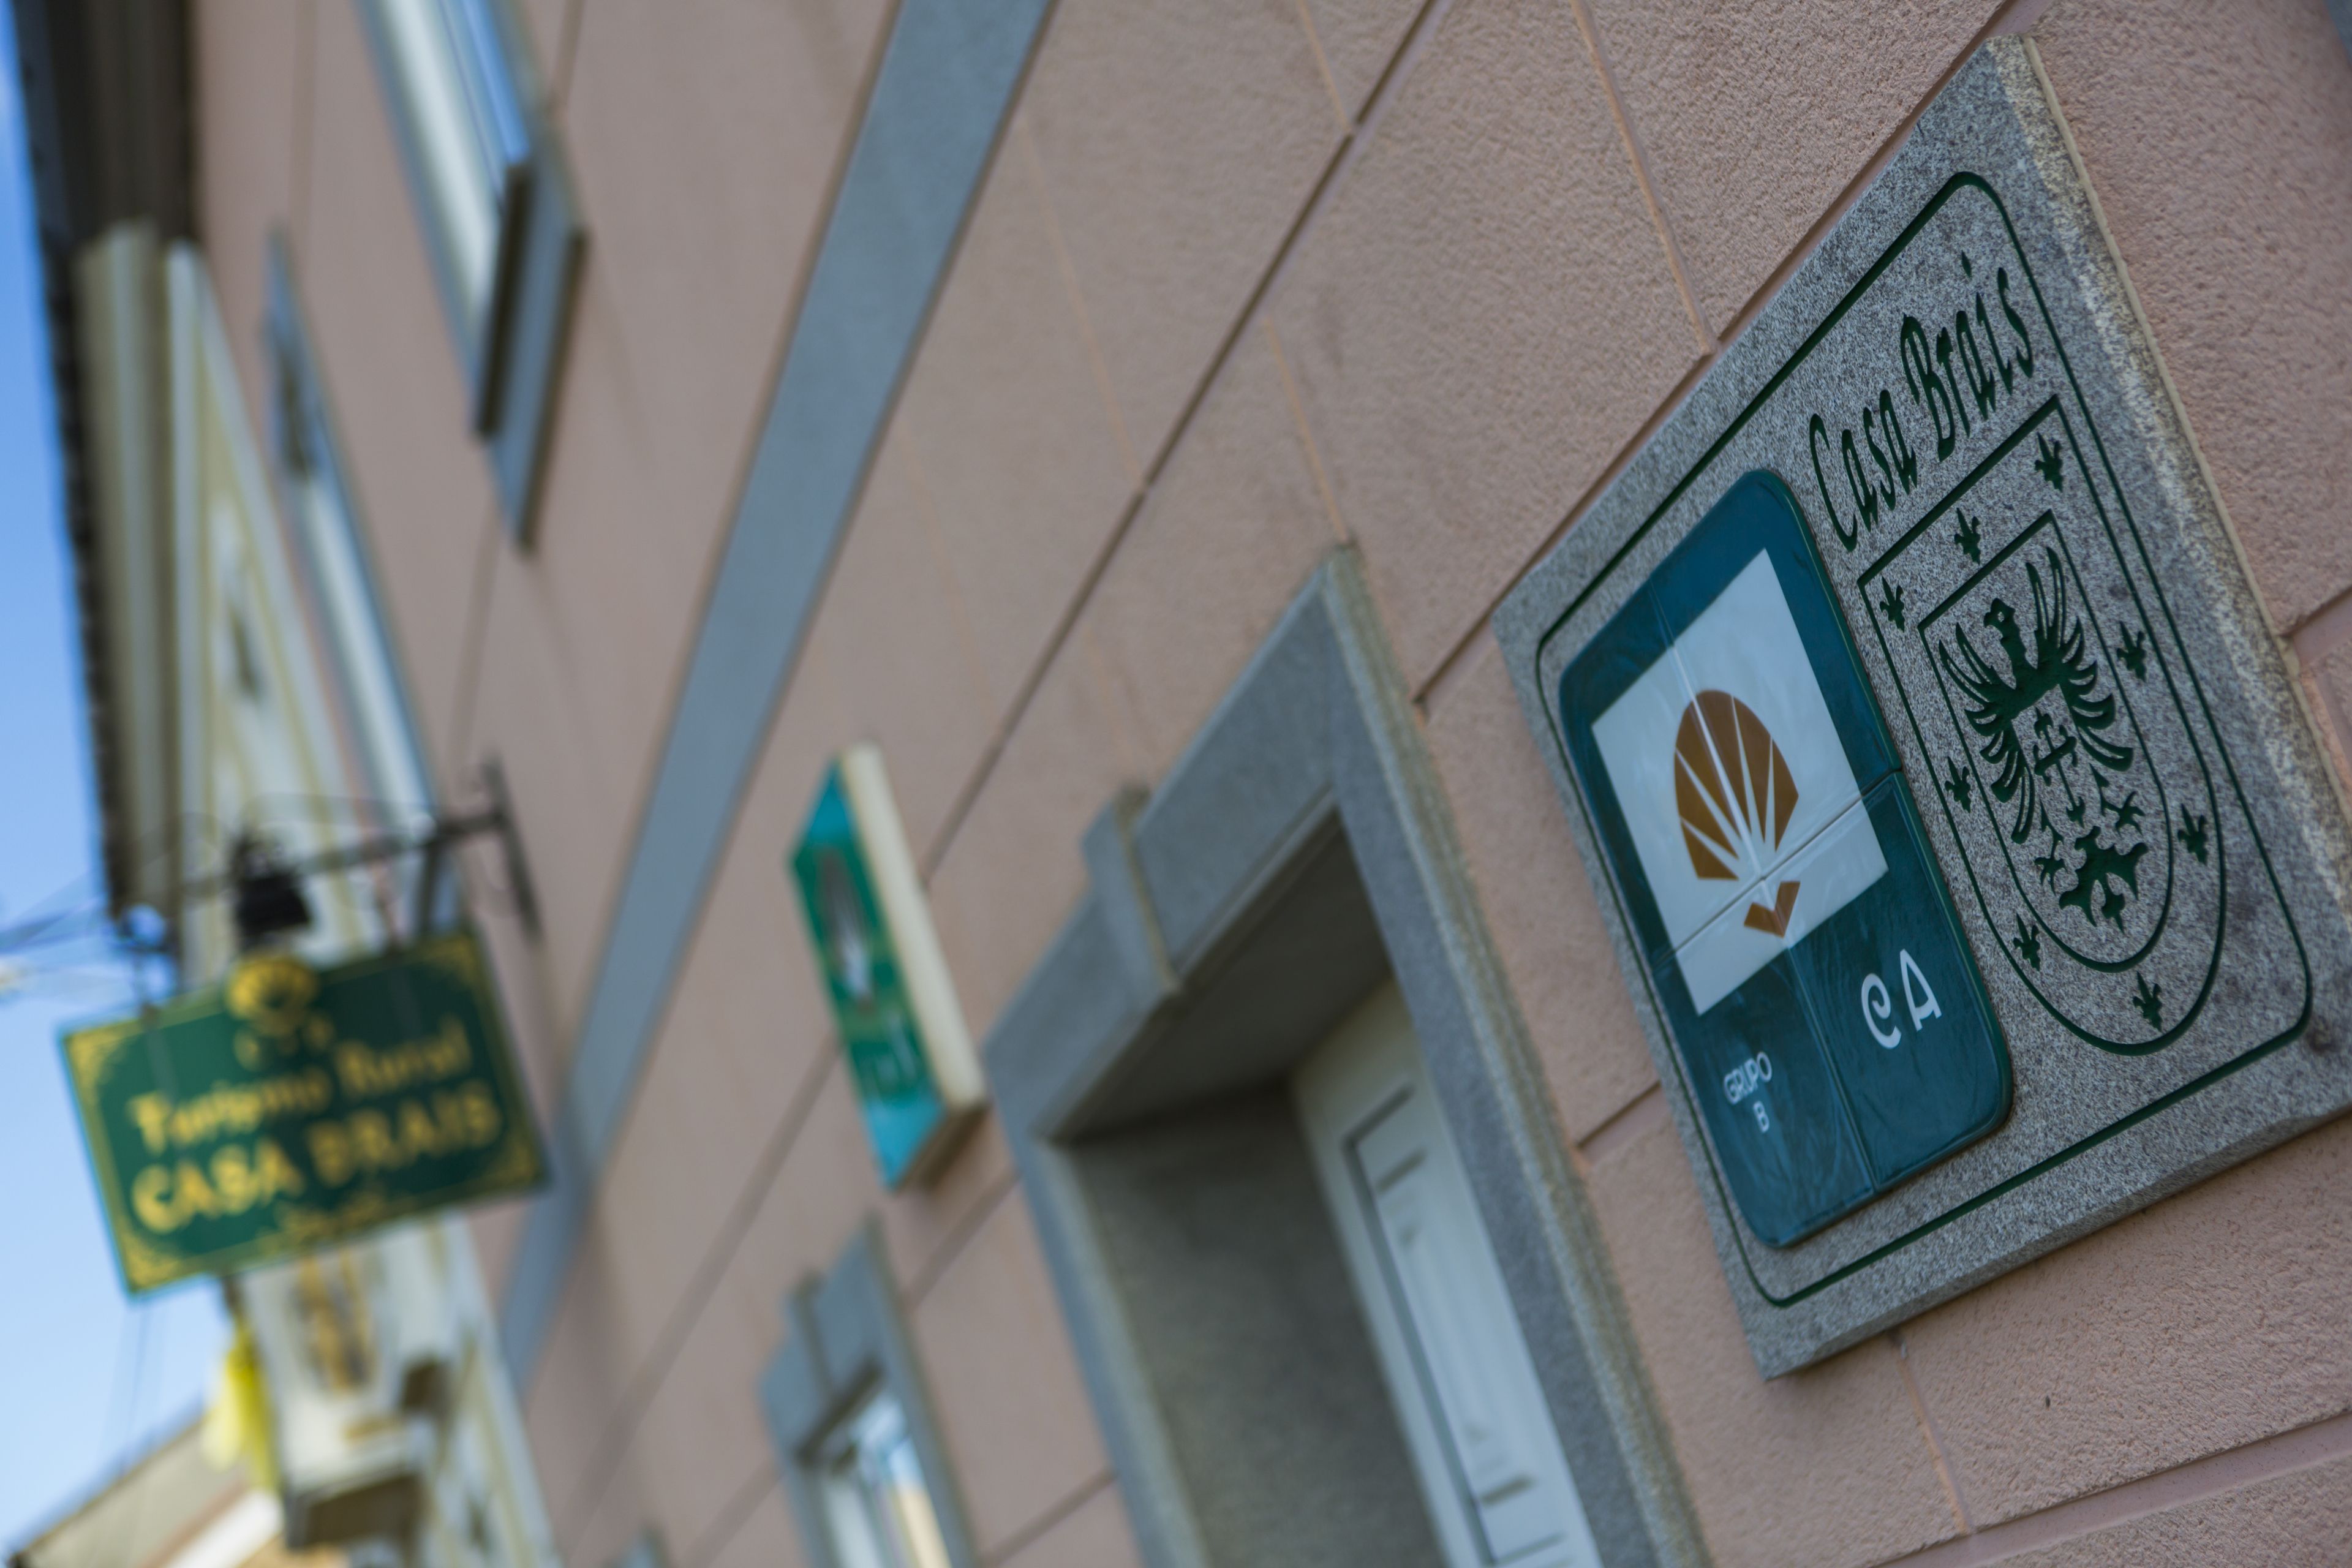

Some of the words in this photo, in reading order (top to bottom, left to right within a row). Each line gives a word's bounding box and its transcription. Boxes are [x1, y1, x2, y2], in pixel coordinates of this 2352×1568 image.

[1809, 390, 1917, 551] Casa
[1900, 251, 2033, 462] Brais
[130, 1067, 331, 1153] Turismo
[335, 1016, 472, 1097] Rural
[1723, 1051, 1773, 1104] GRUPO
[1752, 1101, 1770, 1133] B
[132, 1137, 306, 1233] CASA
[307, 1080, 500, 1185] BRAIS
